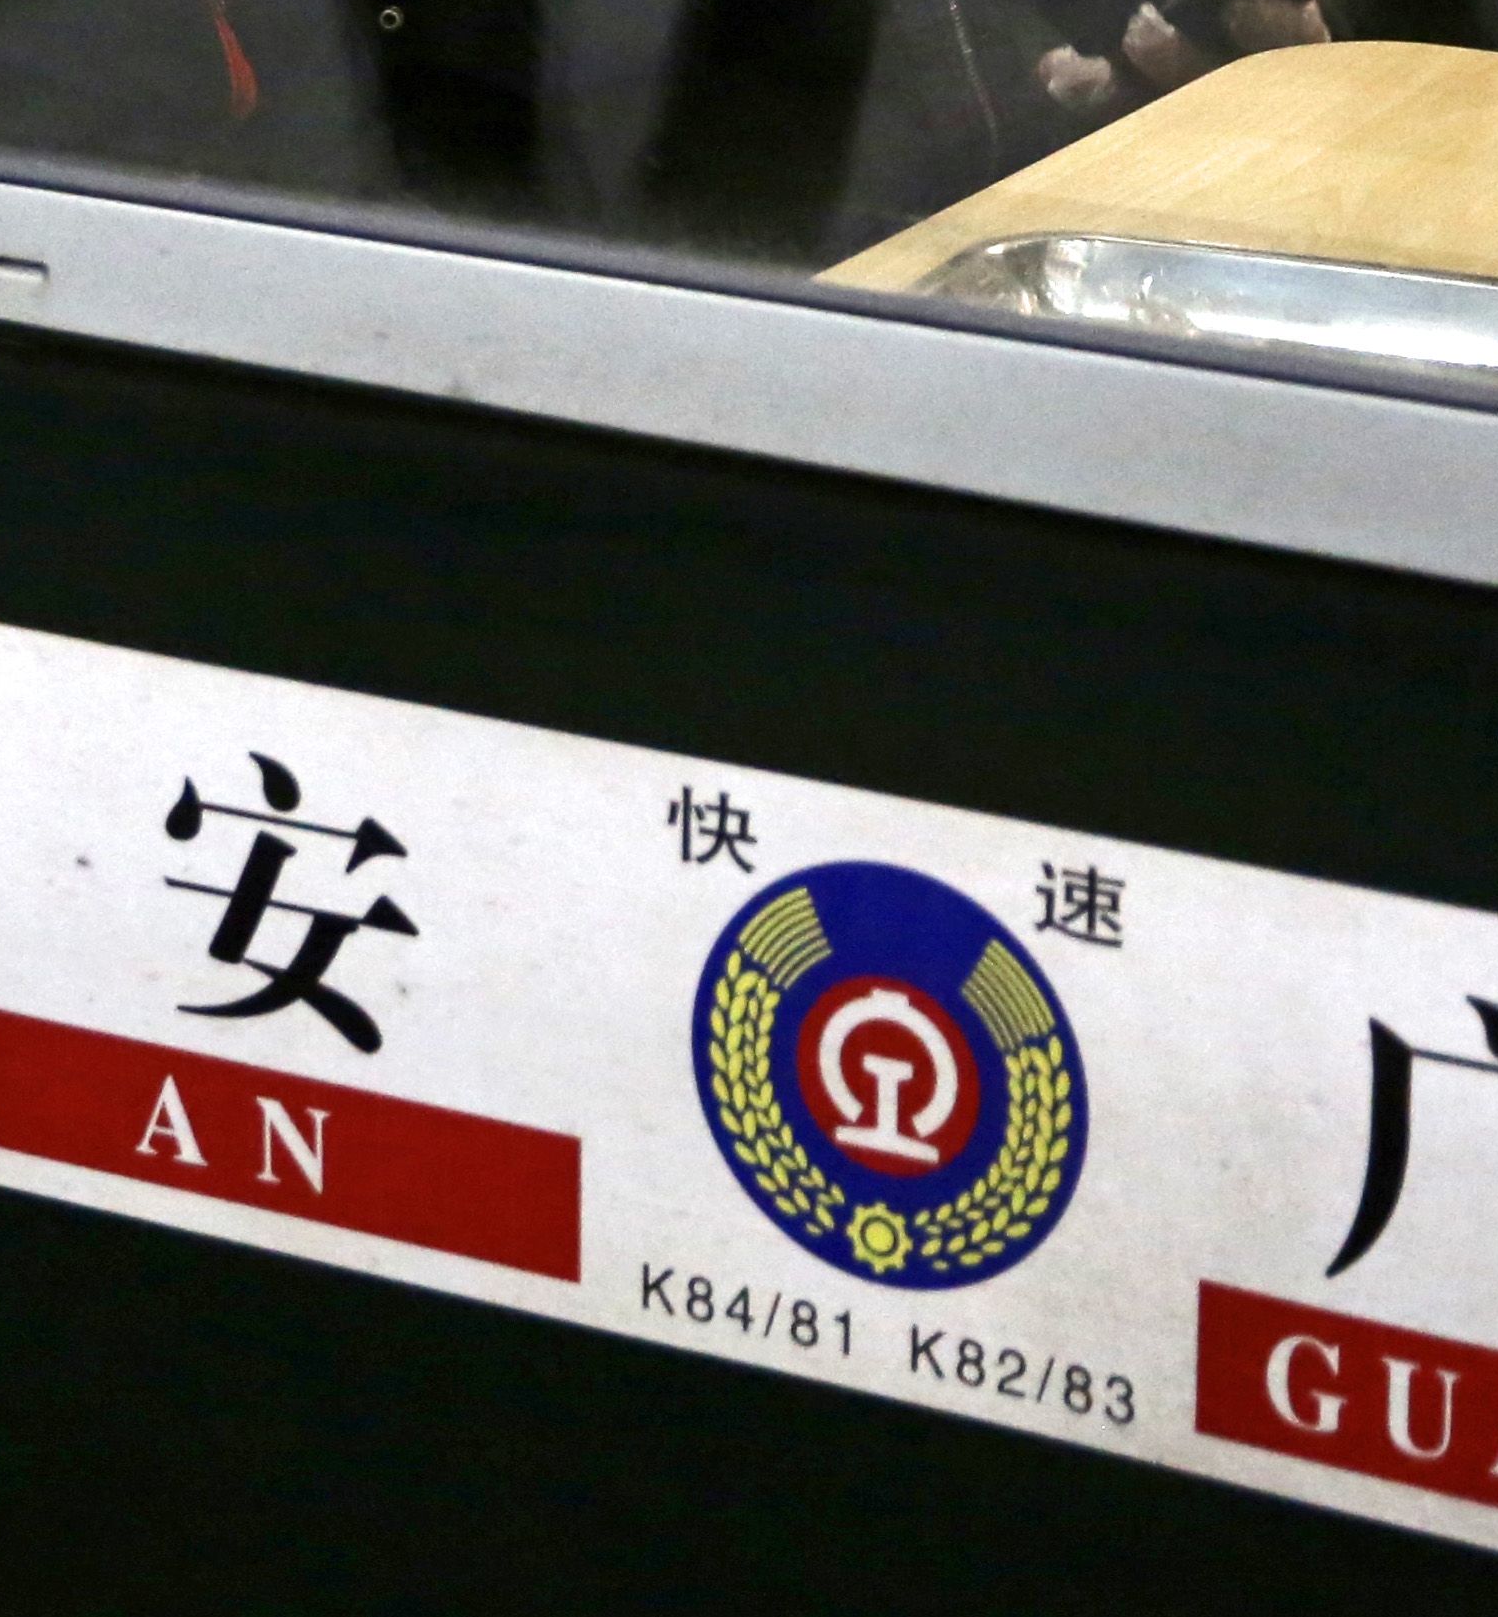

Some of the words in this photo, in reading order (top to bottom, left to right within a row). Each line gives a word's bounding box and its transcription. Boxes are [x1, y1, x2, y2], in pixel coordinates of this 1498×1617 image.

[135, 1074, 331, 1195] AN
[641, 1263, 854, 1357] K84/81
[909, 1324, 1138, 1426] K82/83
